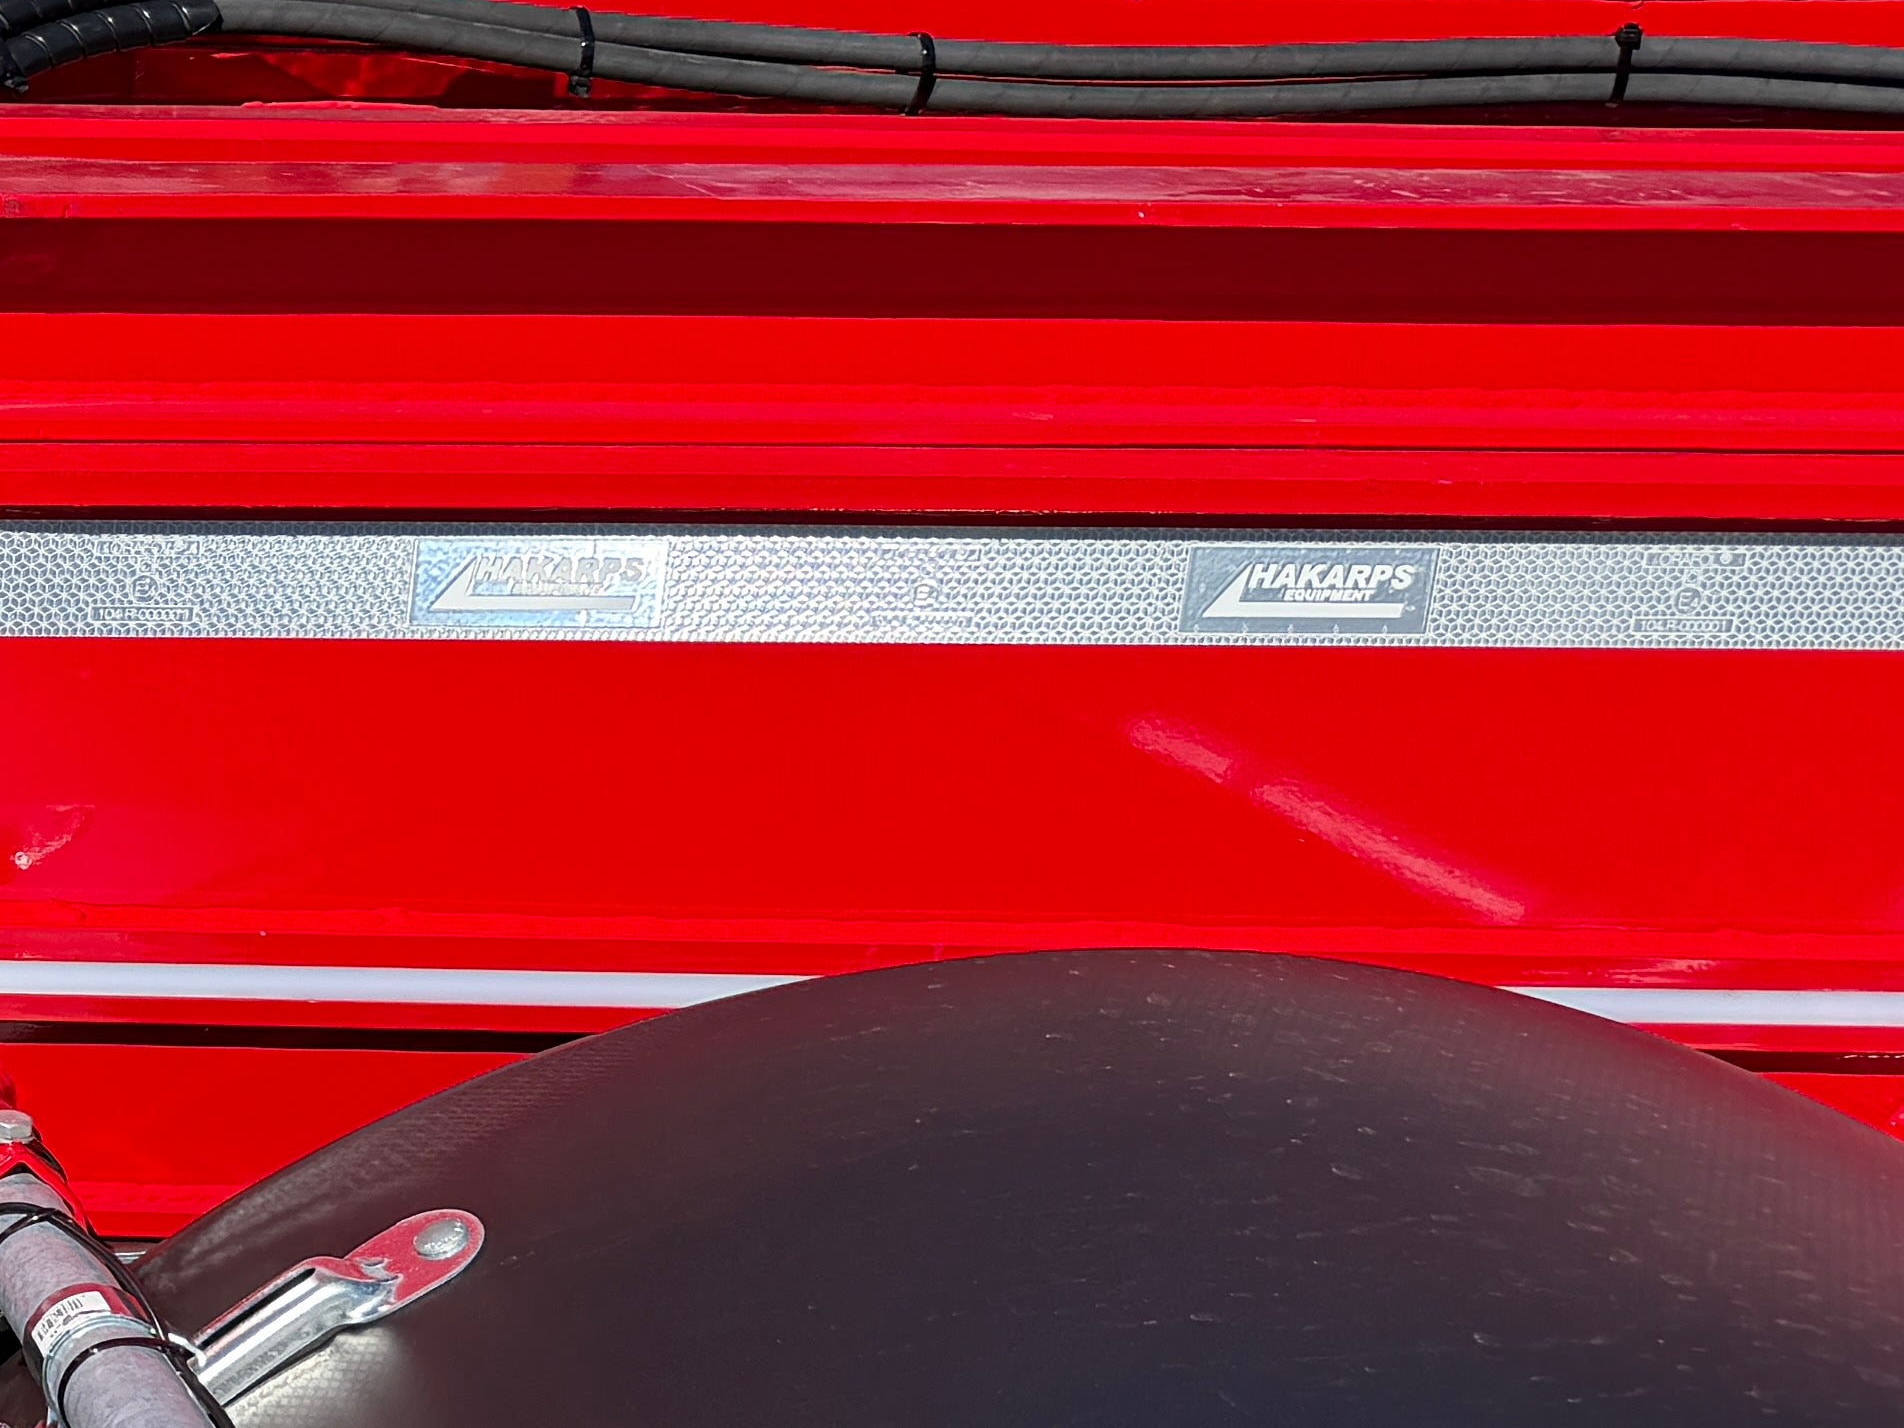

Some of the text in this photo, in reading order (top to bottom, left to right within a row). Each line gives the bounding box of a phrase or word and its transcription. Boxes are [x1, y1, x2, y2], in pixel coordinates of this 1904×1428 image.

[474, 555, 645, 583] HAKARPS
[1247, 562, 1417, 591] HAKARPS
[1282, 589, 1376, 603] EQUIPMENT
